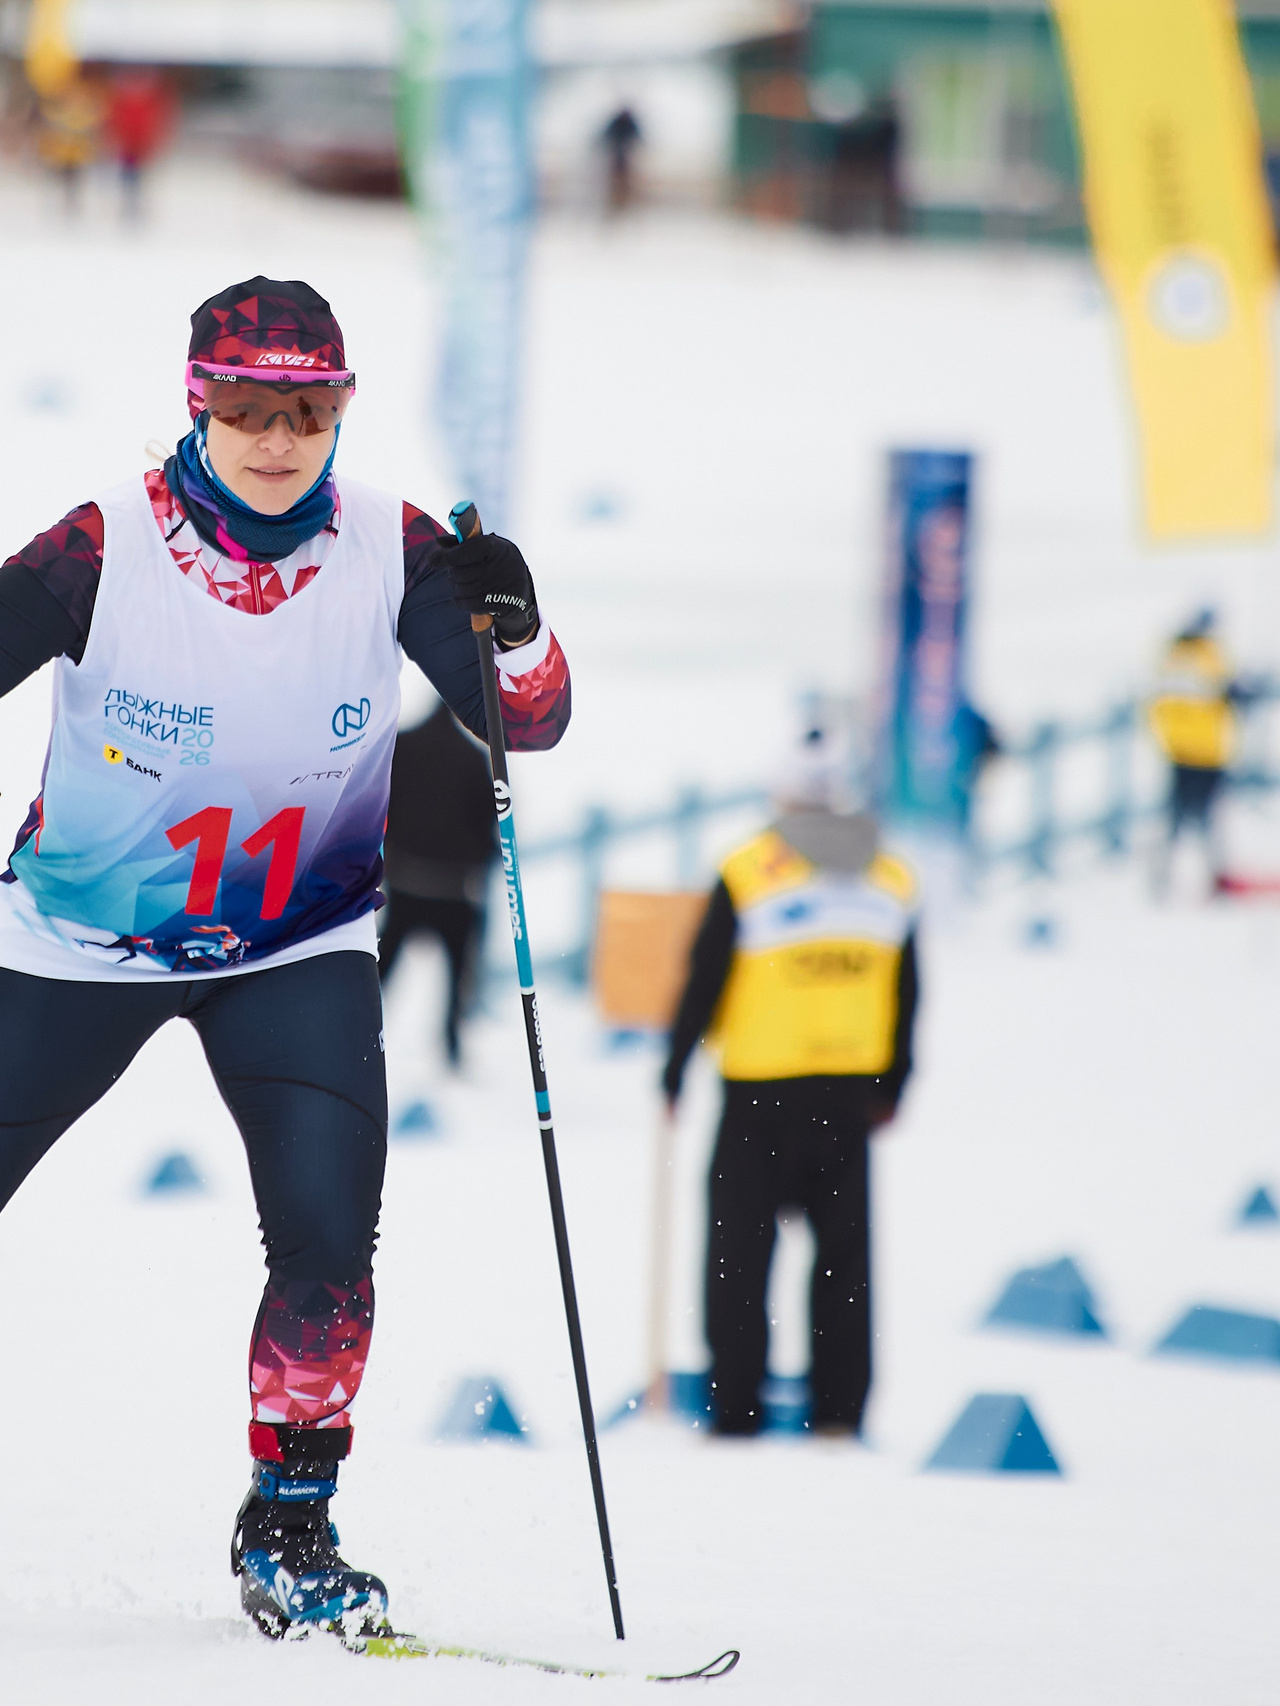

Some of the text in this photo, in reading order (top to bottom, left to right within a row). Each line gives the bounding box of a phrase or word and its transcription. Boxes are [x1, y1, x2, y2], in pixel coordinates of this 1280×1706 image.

[104, 689, 214, 726] ЛЫЖНЫЕ
[104, 704, 214, 749] ГОНКИ 20
[126, 758, 162, 783] БАНК
[179, 749, 210, 765] 26
[164, 806, 306, 920] 11
